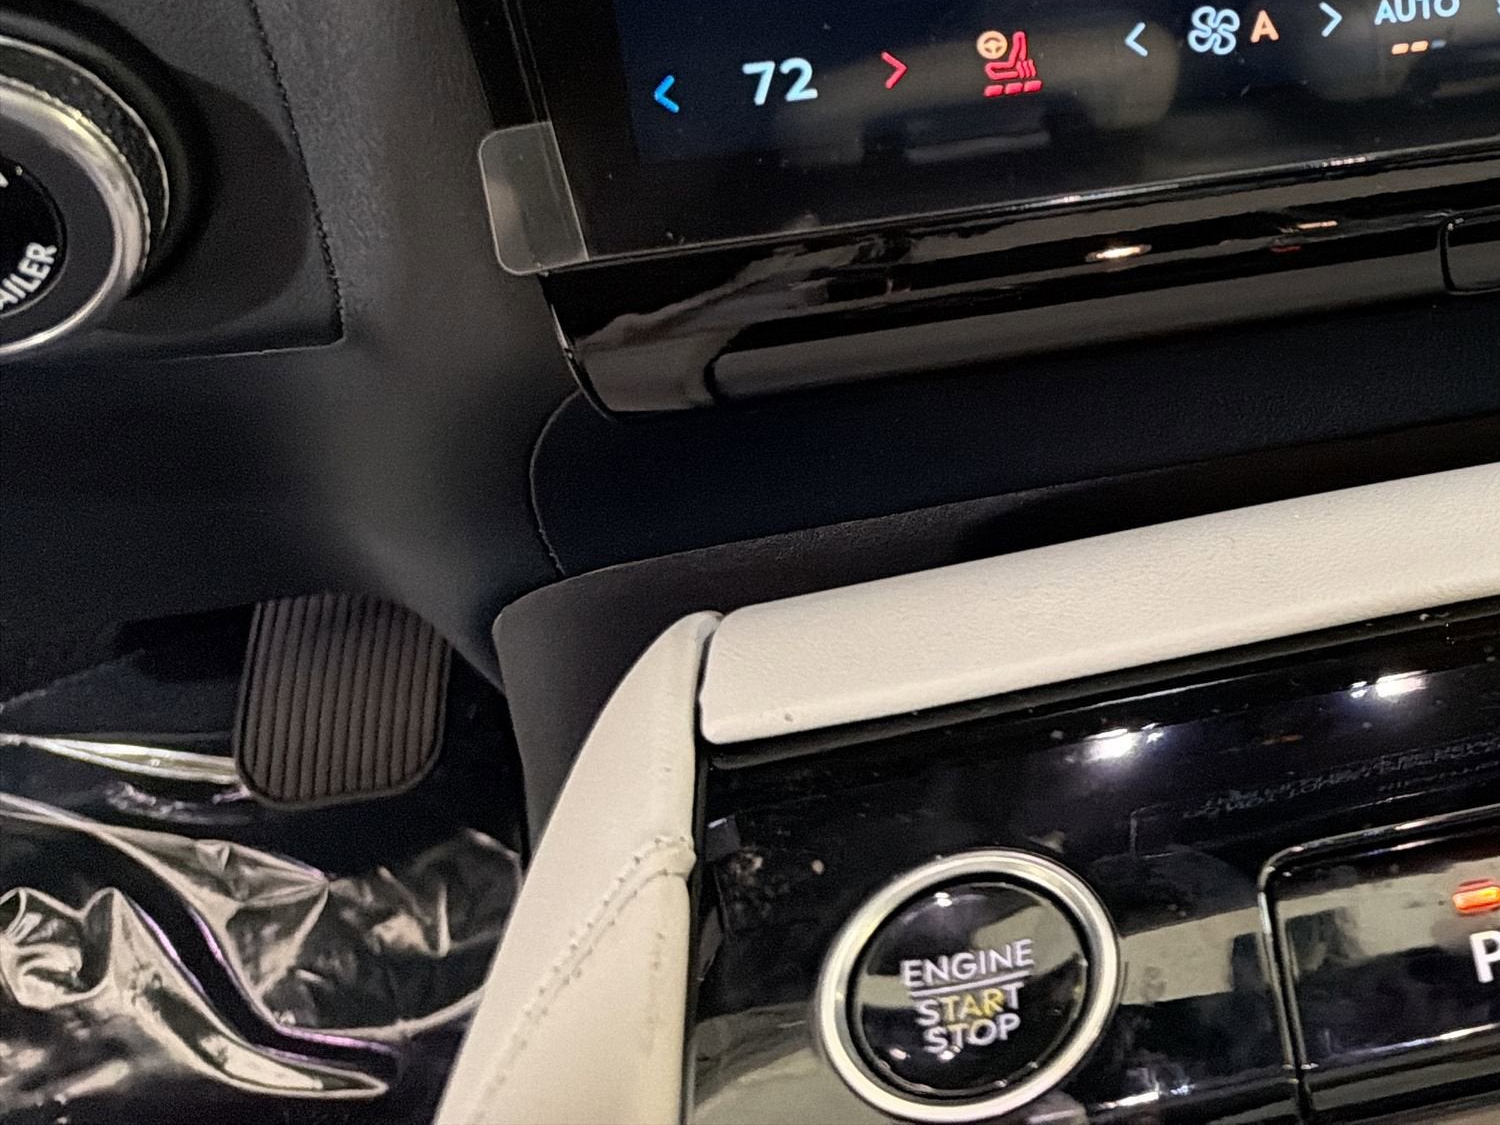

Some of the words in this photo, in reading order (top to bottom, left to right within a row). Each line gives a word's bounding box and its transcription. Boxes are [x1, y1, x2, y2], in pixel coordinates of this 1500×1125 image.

[742, 57, 820, 106] 72
[901, 938, 1035, 988] ENGINE
[916, 981, 1025, 1026] START
[923, 1012, 1022, 1054] STOP
